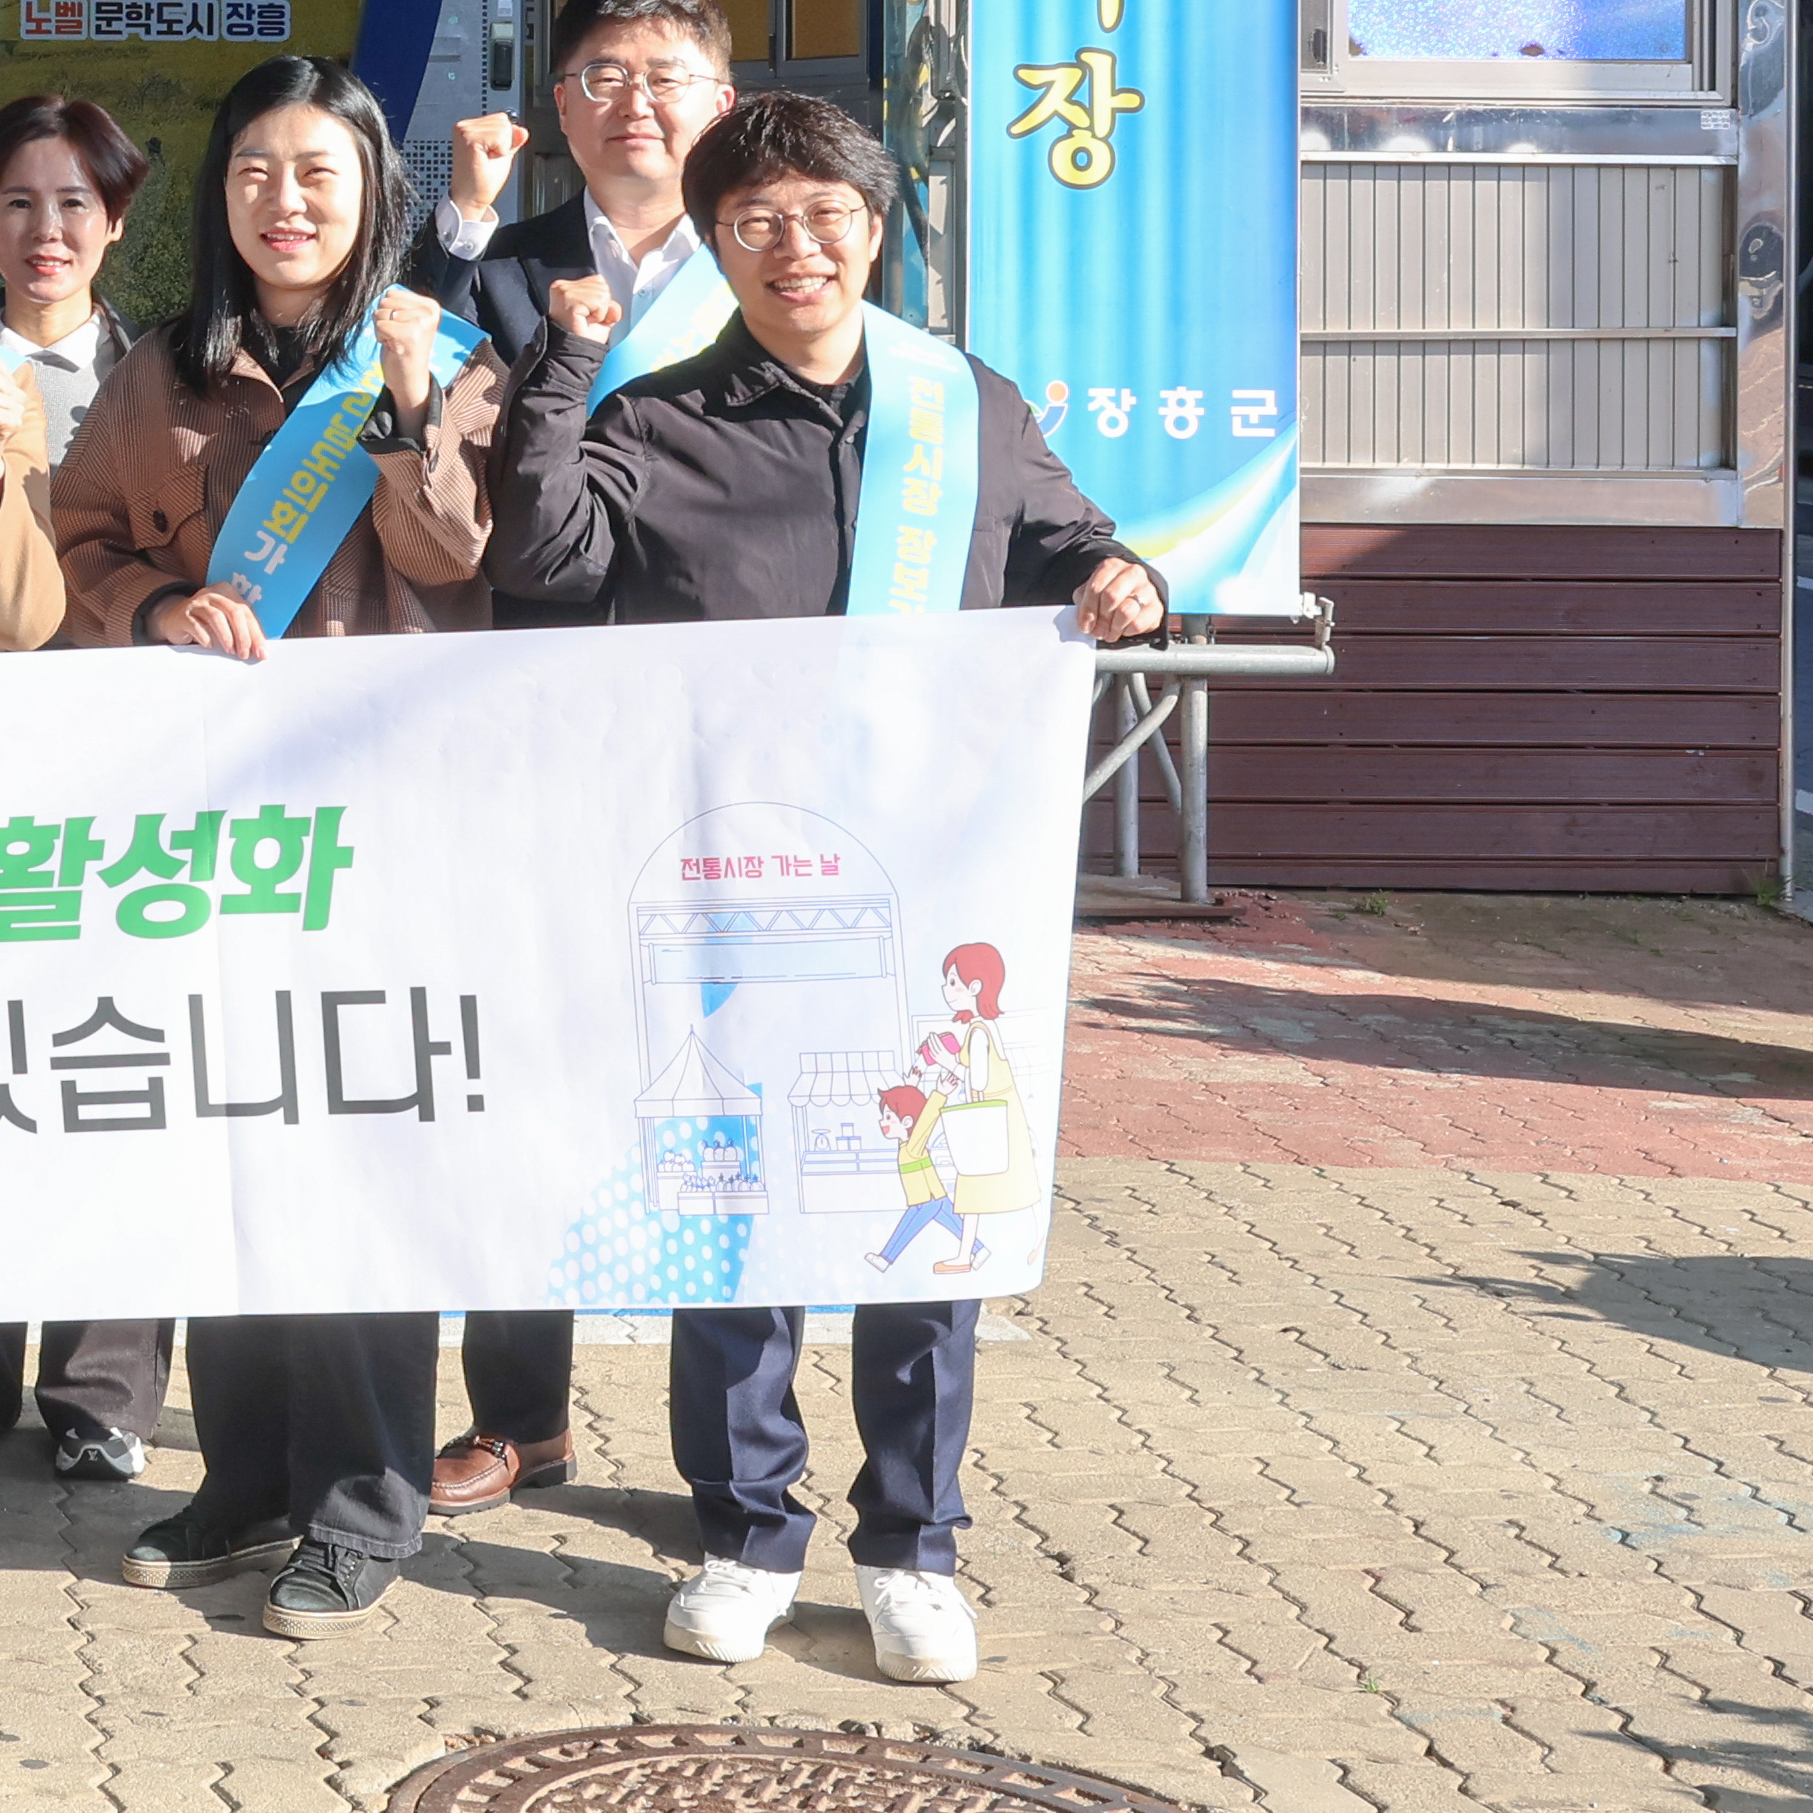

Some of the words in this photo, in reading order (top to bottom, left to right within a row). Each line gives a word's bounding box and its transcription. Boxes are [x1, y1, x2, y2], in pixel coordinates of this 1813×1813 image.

[24, 1, 84, 36] 노벨
[94, 0, 216, 36] 문학도시
[224, 1, 289, 36] 장흥
[679, 856, 764, 882] 전통시장
[771, 855, 814, 878] 가는
[819, 853, 841, 877] 날
